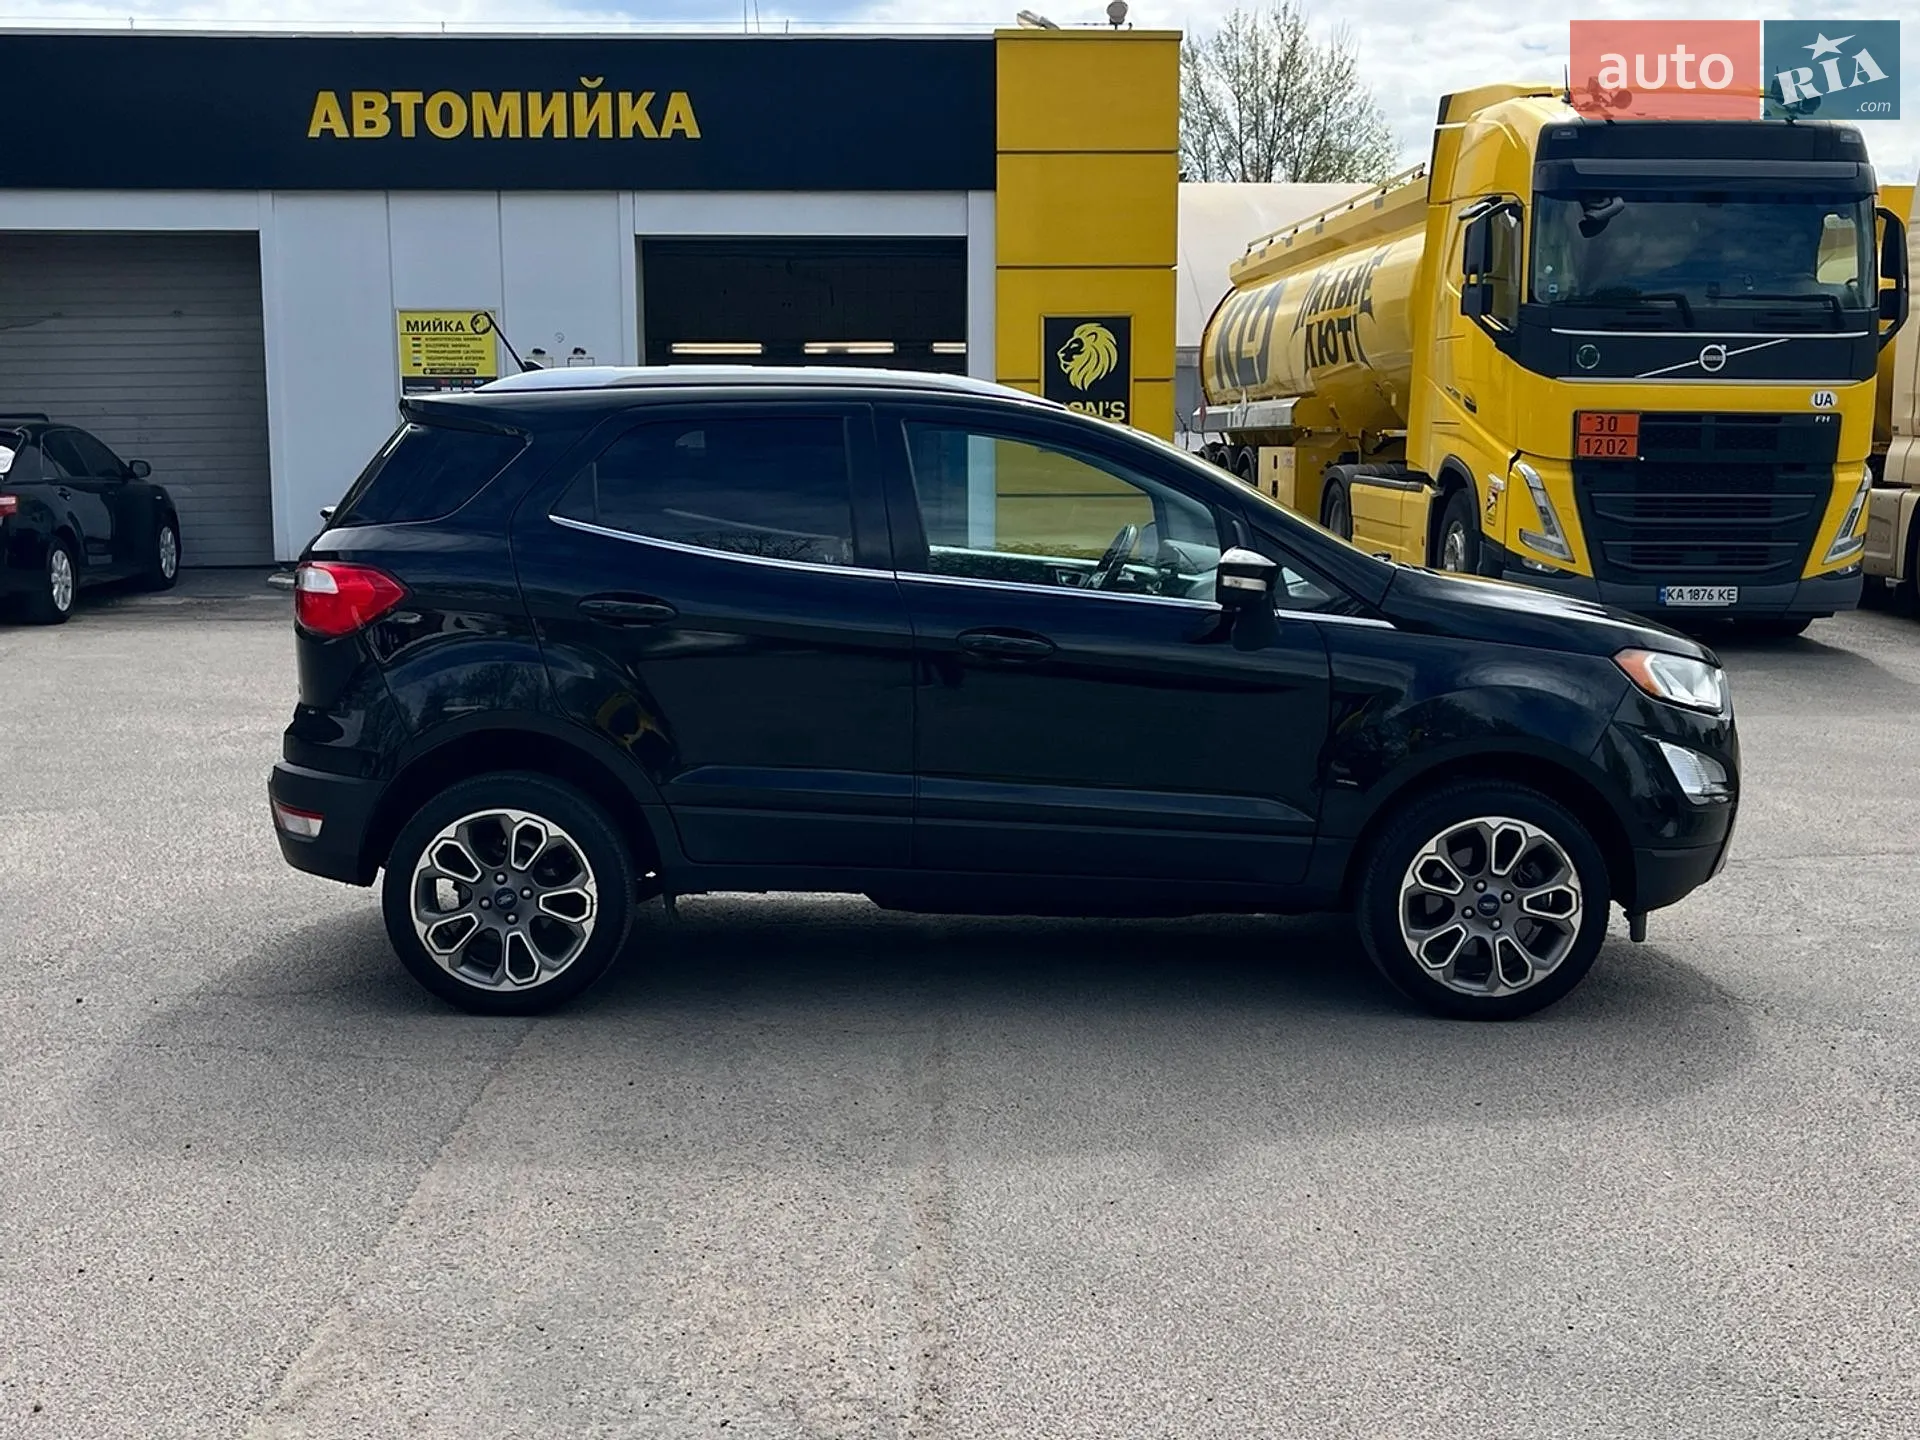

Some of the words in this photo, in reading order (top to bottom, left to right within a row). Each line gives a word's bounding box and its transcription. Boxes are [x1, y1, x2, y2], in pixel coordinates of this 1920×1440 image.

[307, 76, 701, 138] АВТОМИЙКА
[406, 317, 465, 332] МИЙКА
[1813, 393, 1833, 406] UA
[1594, 416, 1618, 432] 30
[1584, 438, 1628, 455] 1202
[1687, 588, 1714, 601] 1876
